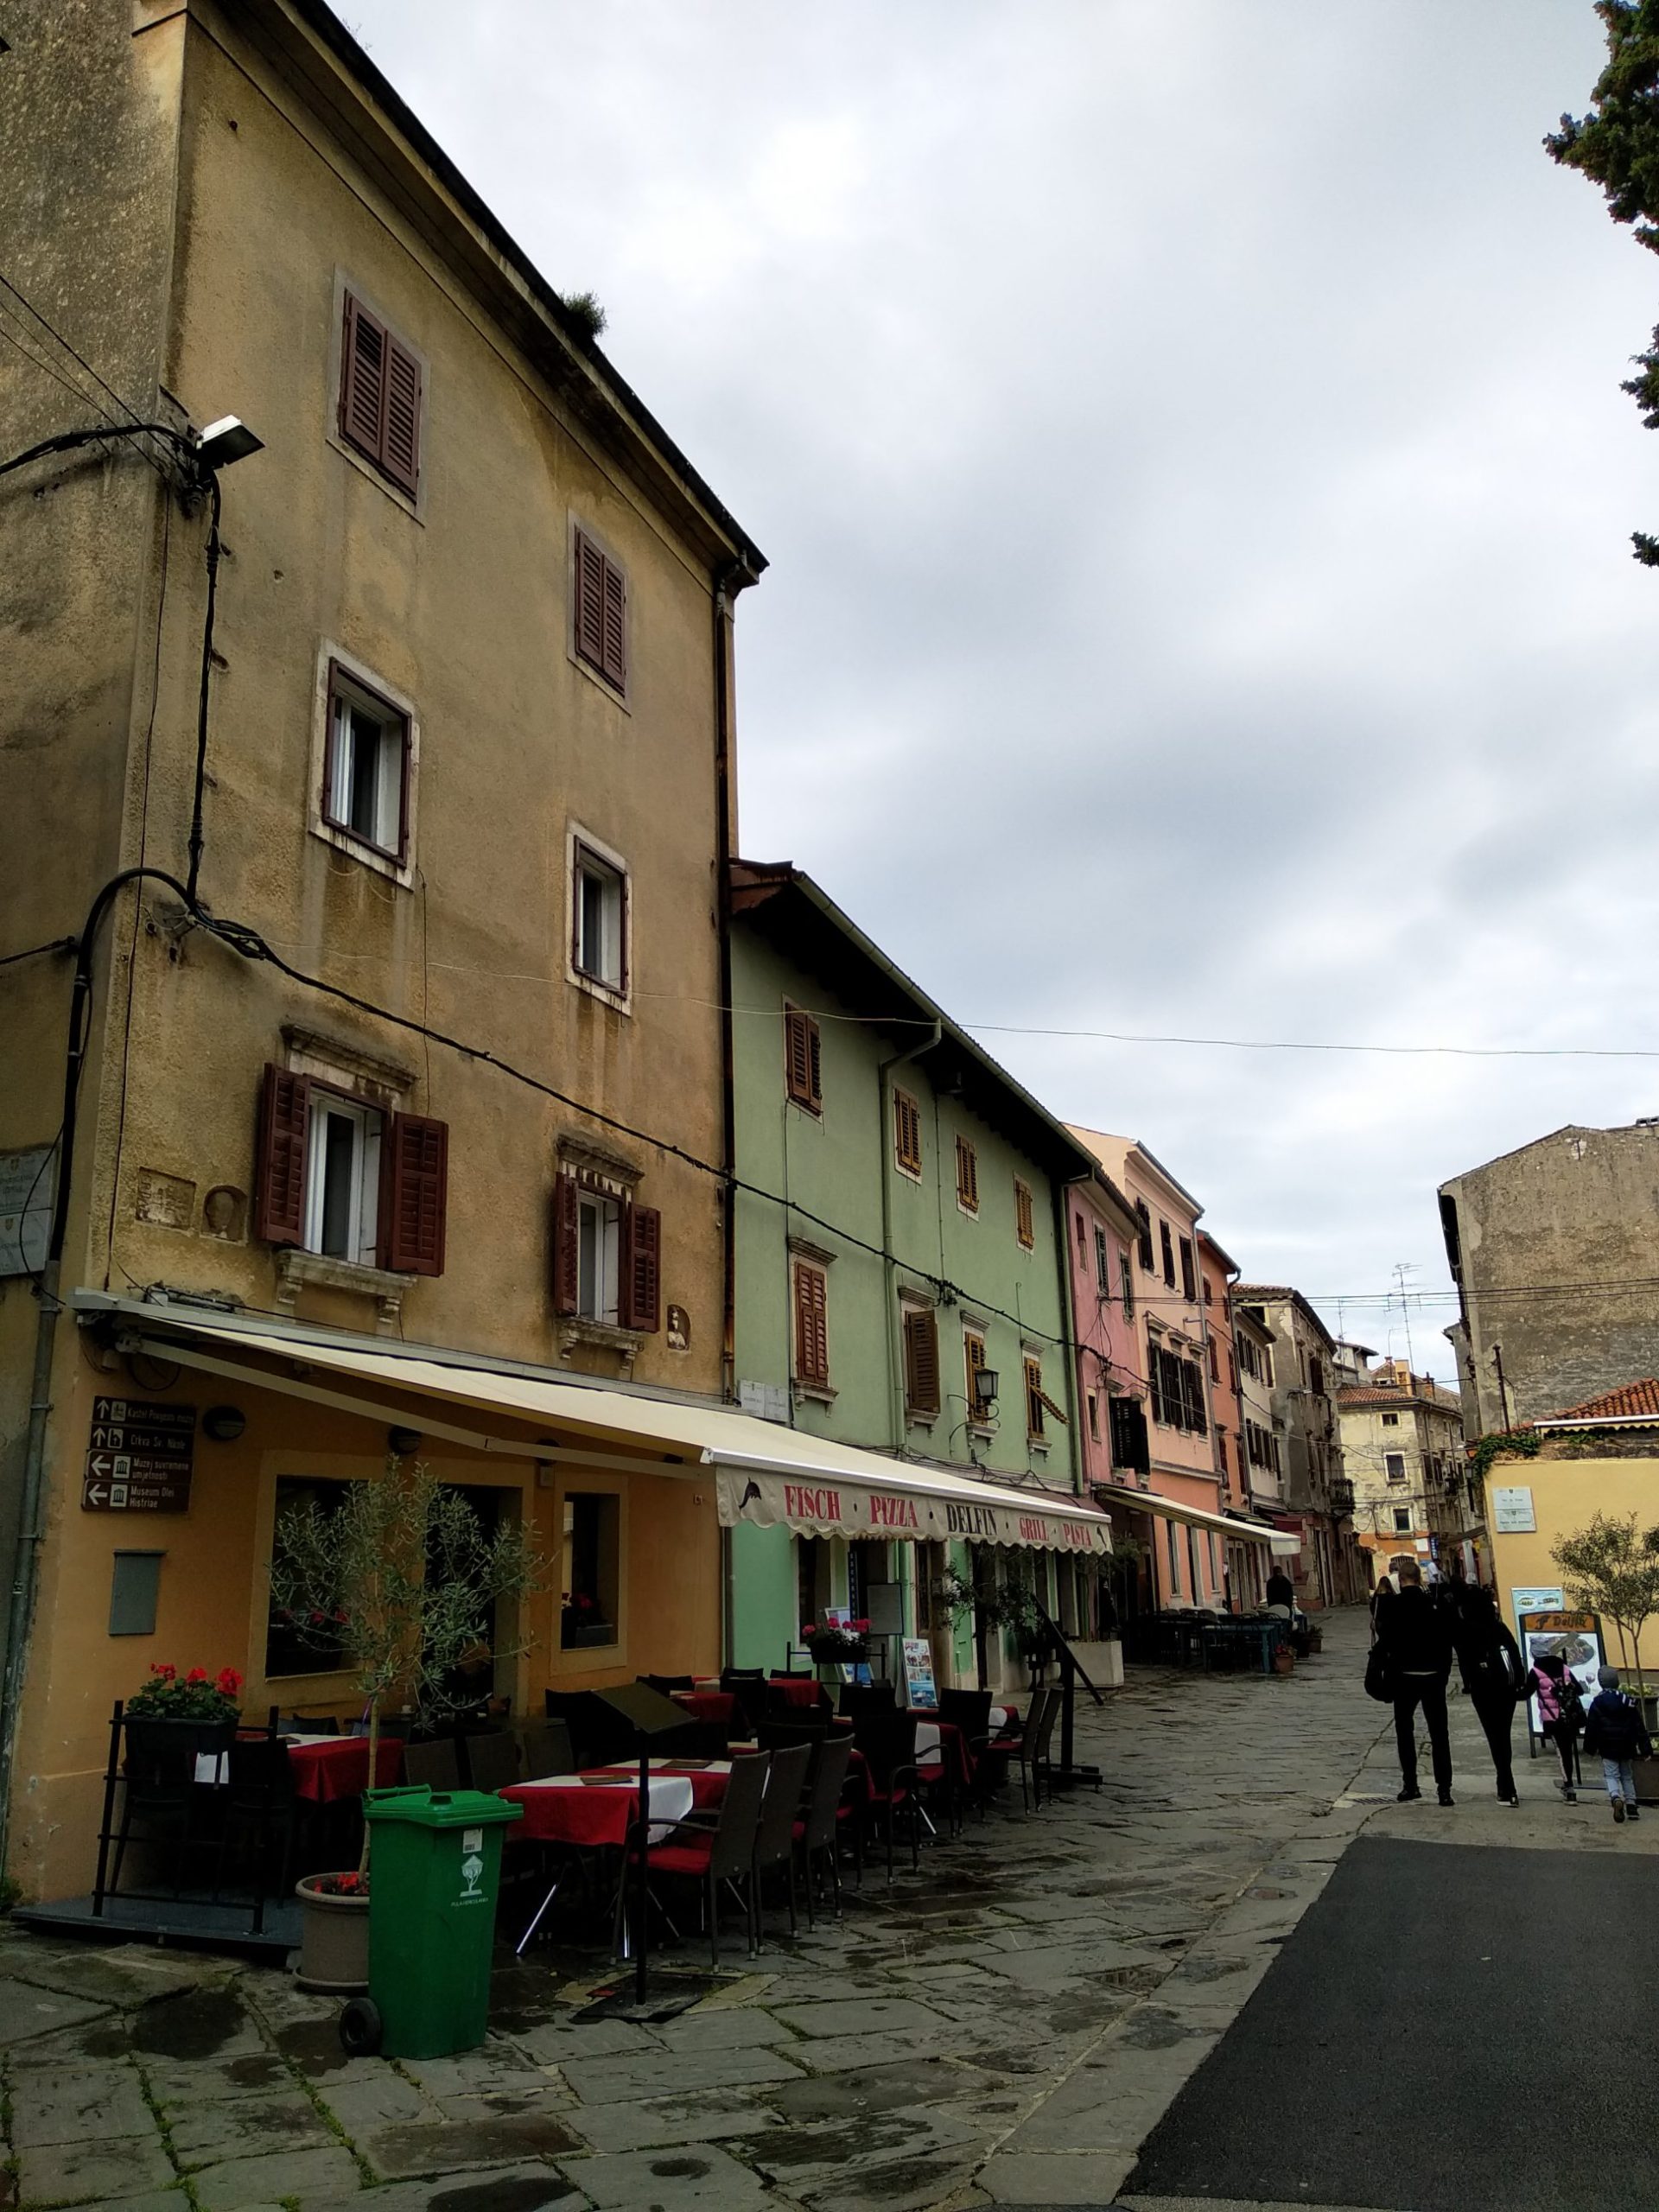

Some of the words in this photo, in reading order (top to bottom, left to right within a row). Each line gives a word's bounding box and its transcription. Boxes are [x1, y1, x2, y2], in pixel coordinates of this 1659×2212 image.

[133, 1457, 153, 1471] Muzej
[130, 1485, 160, 1497] Museum
[130, 1497, 158, 1509] Histriae
[784, 1484, 842, 1521] FISCH
[869, 1495, 918, 1529] PIZZA
[946, 1503, 997, 1535] DELFIN
[1020, 1516, 1050, 1541] GRILL
[1062, 1522, 1092, 1547] PASTA
